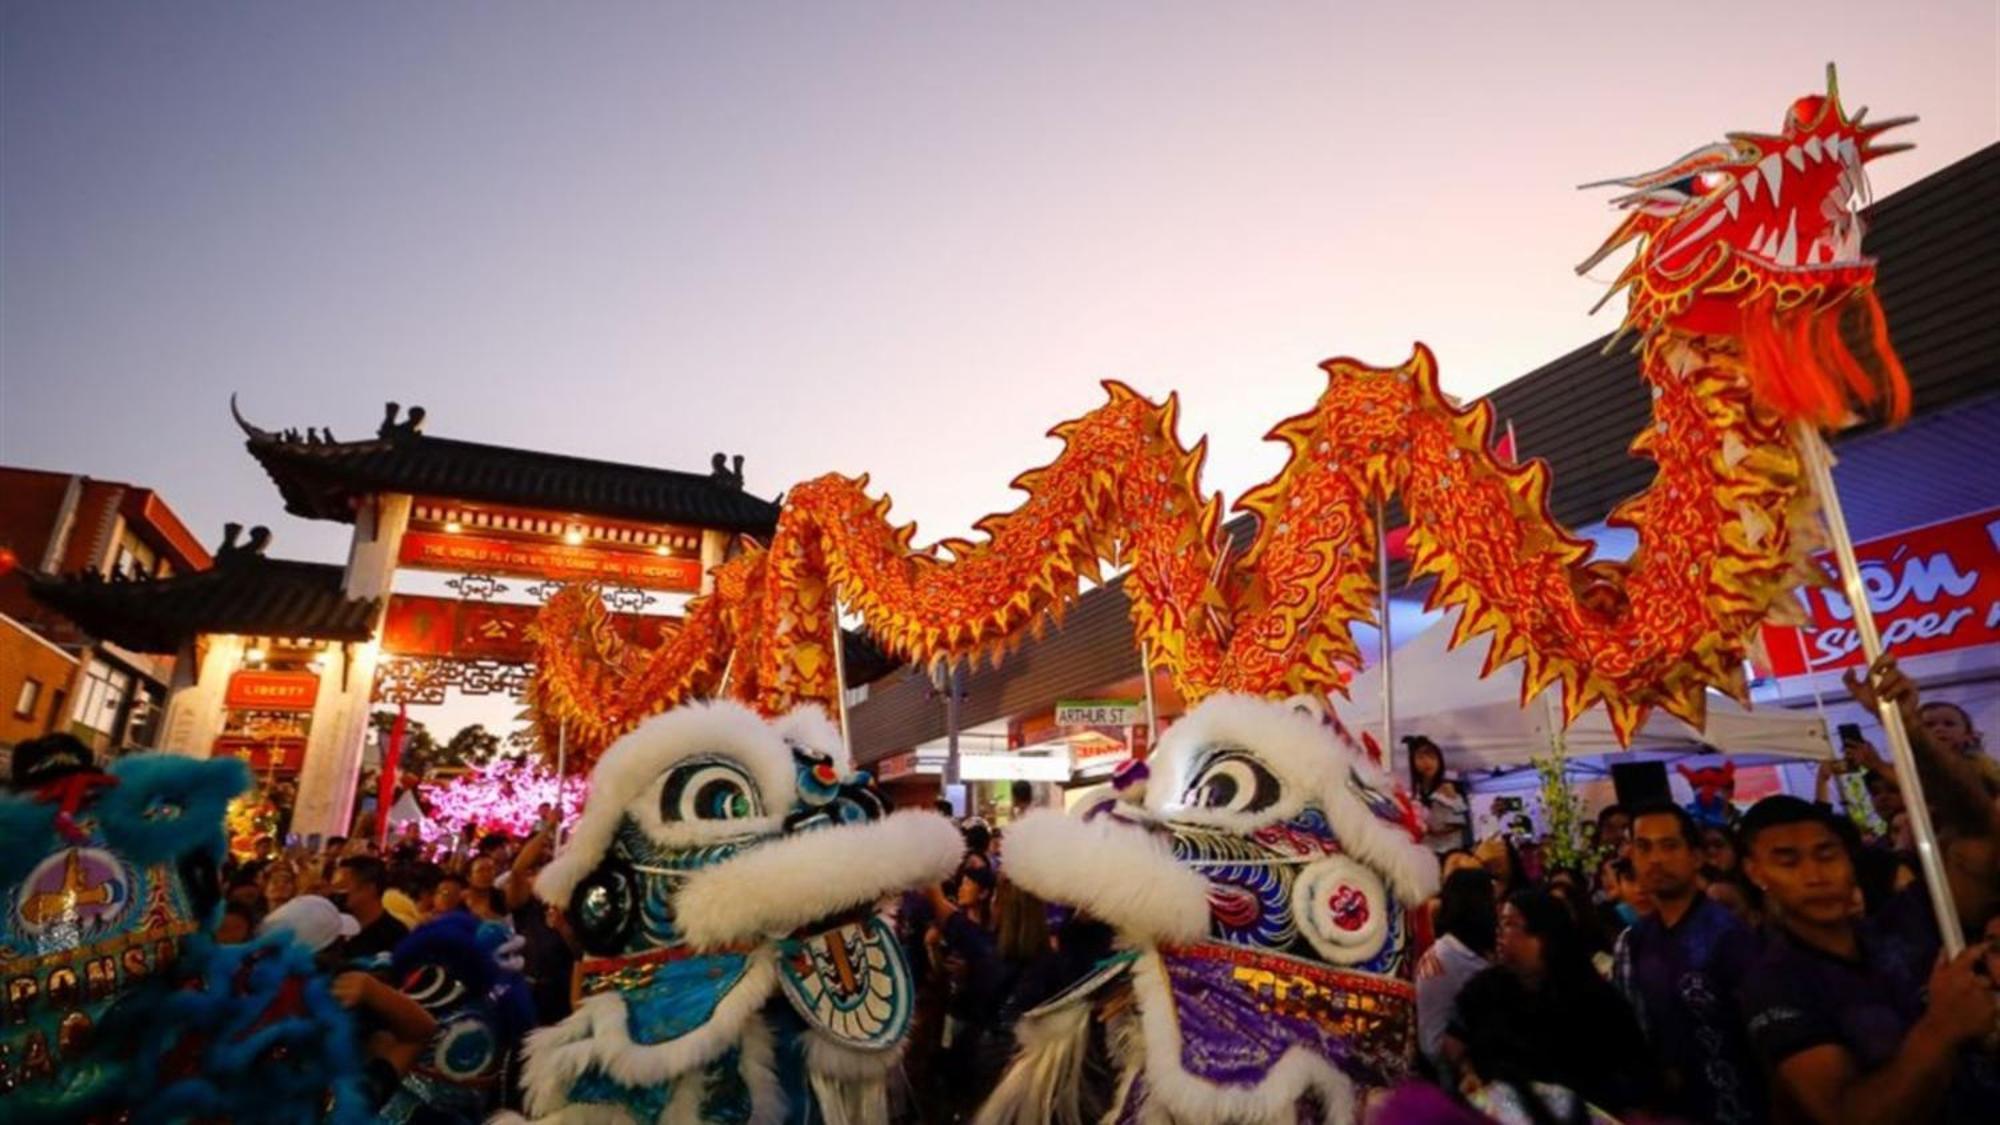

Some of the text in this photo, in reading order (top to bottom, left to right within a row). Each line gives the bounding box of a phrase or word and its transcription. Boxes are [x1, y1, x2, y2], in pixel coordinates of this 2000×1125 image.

[243, 684, 305, 697] LIBERTY
[1059, 708, 1125, 723] ARTHUR ST
